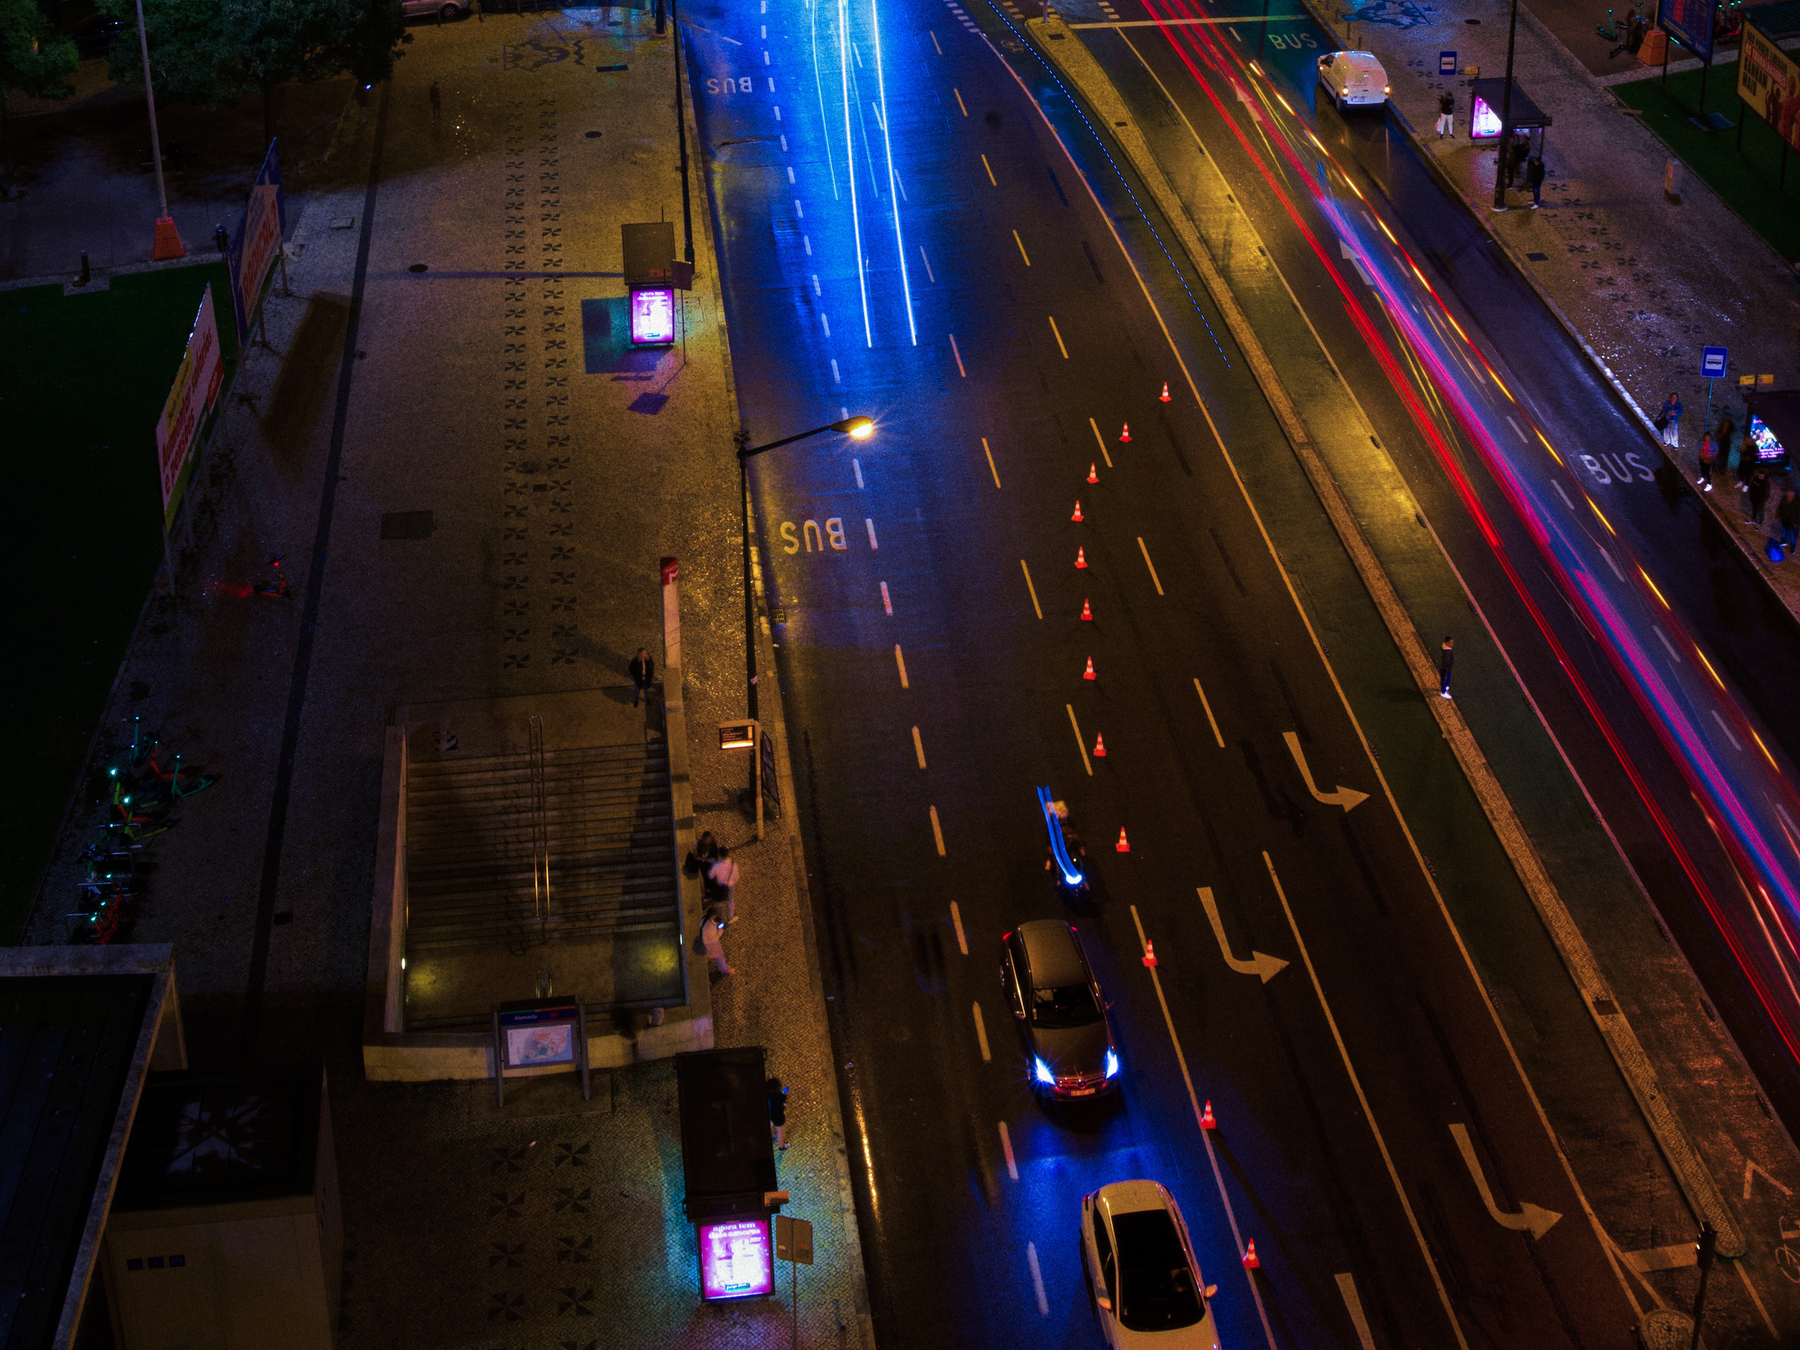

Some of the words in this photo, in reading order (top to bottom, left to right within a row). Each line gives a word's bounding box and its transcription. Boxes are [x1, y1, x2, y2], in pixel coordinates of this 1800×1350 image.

[1267, 33, 1317, 49] BUS
[706, 77, 752, 95] BUS
[1580, 453, 1655, 484] BUS
[780, 518, 847, 554] BUS
[713, 1225, 737, 1233] agora
